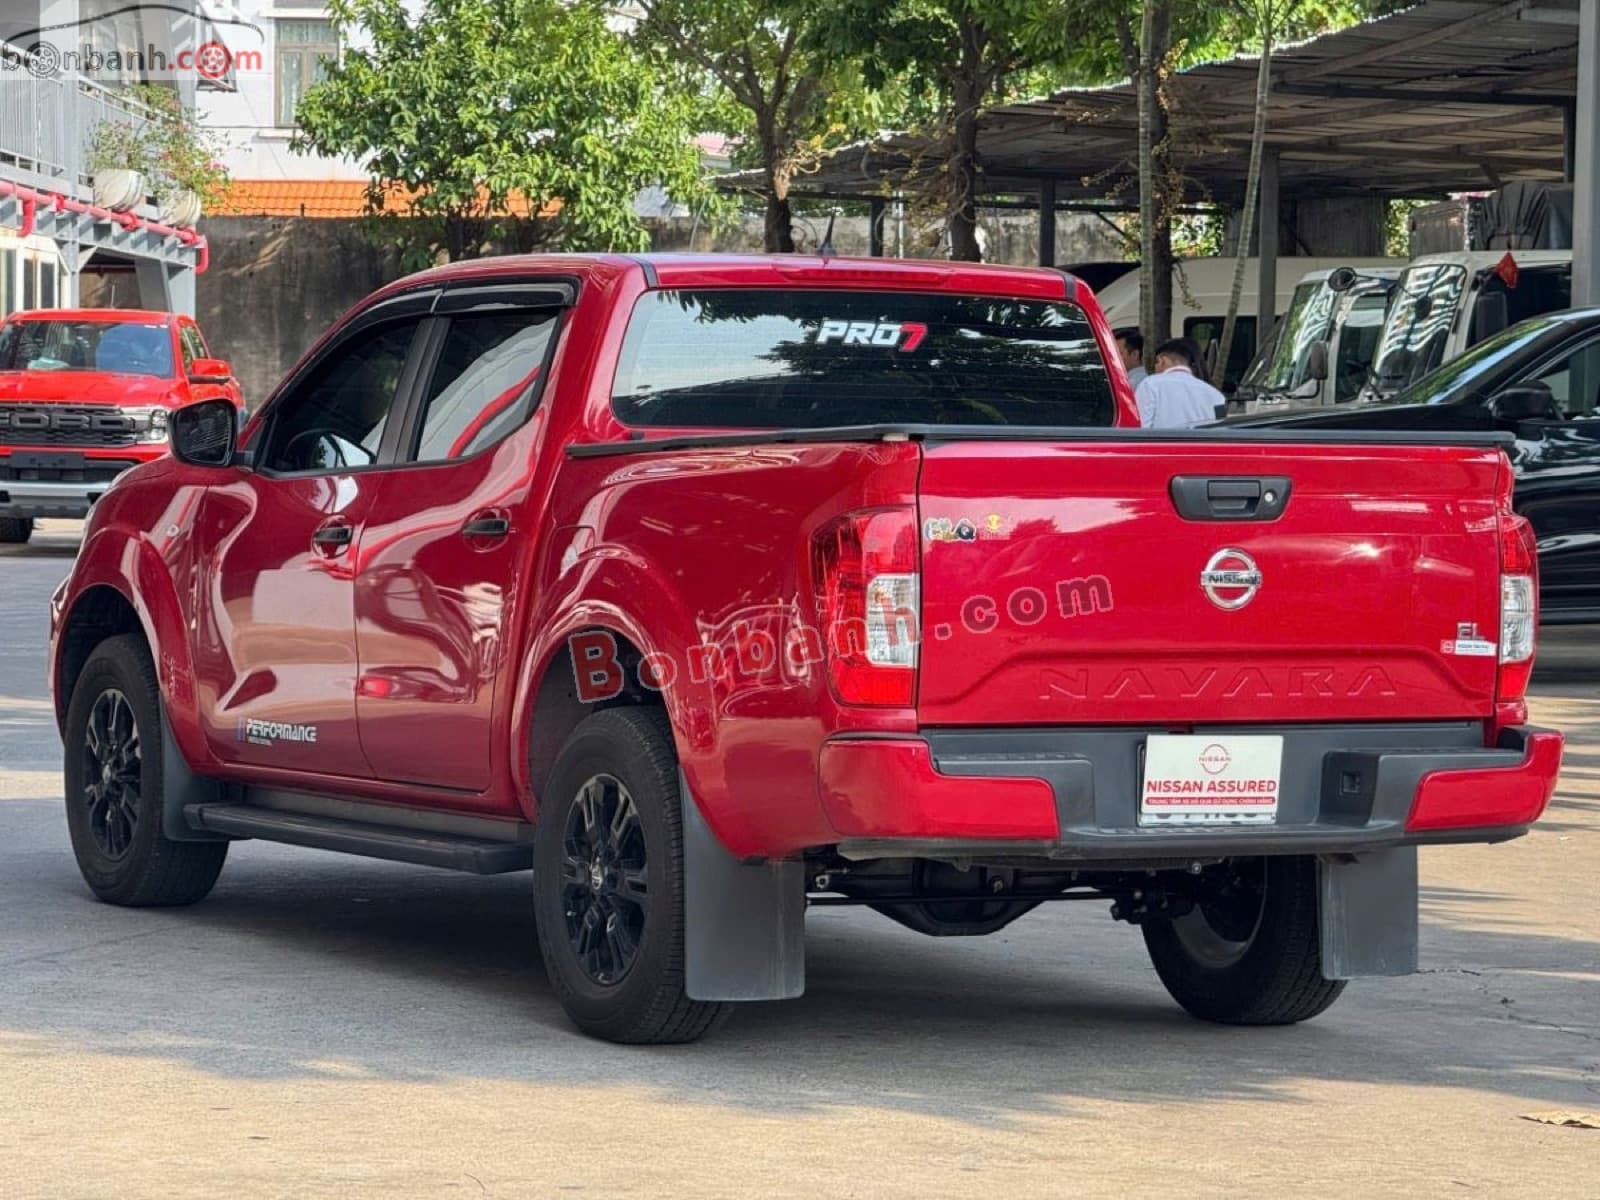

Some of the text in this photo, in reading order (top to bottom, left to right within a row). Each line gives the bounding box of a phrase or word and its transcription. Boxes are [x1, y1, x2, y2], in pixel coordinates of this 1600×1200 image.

[816, 320, 928, 352] PRO7
[0, 411, 135, 431] ORD
[1039, 666, 1397, 699] NAVARA
[246, 718, 318, 743] PERFORMANCE
[1146, 779, 1278, 793] NISSAN ASSURED
